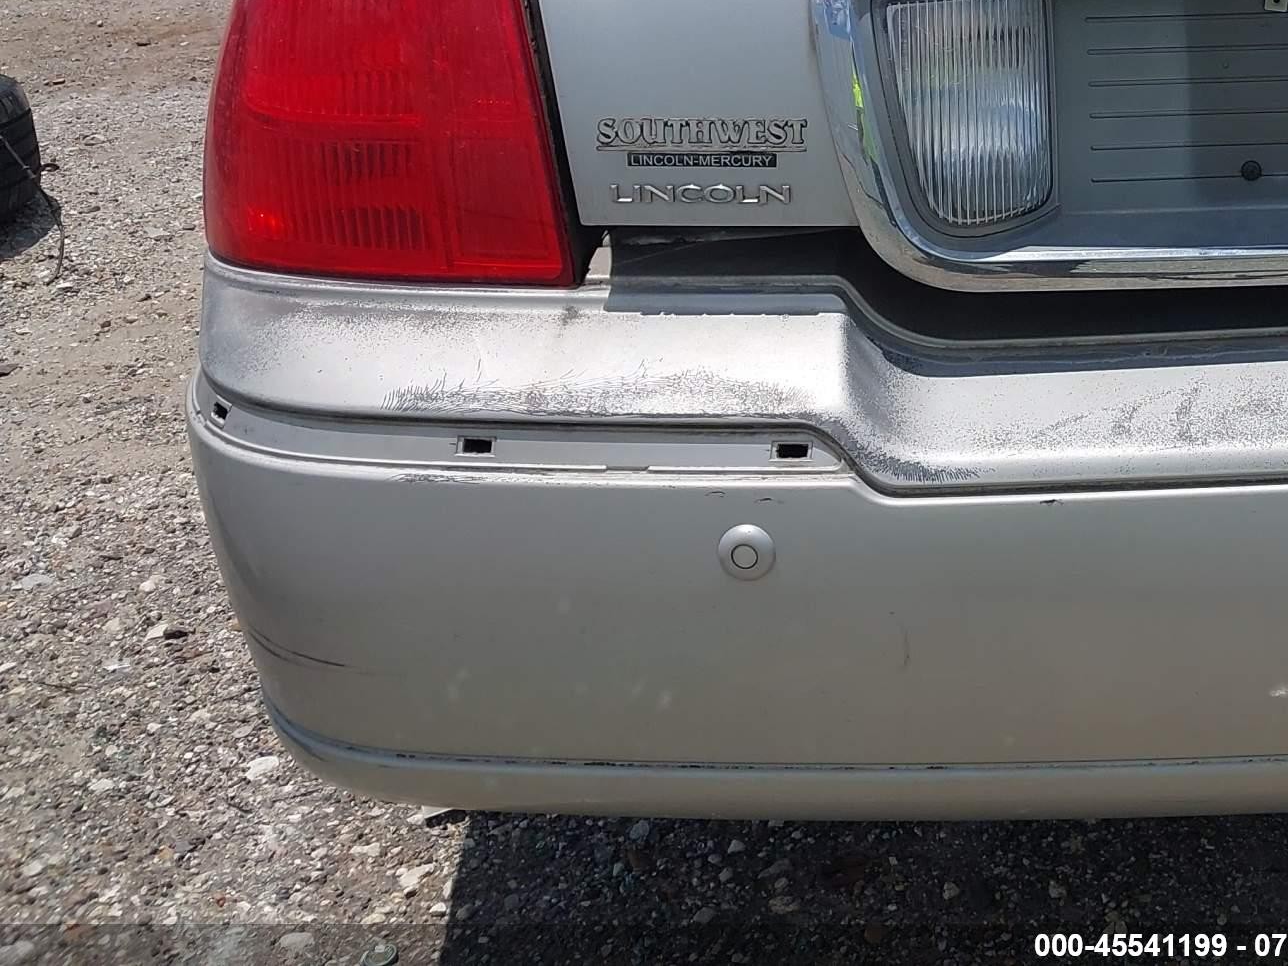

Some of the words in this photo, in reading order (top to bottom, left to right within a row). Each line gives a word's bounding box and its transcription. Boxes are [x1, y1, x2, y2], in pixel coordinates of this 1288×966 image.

[597, 117, 807, 145] SOUTHWEST
[630, 154, 772, 167] LINCOLN-MERCURY
[610, 184, 791, 203] LINCOLN
